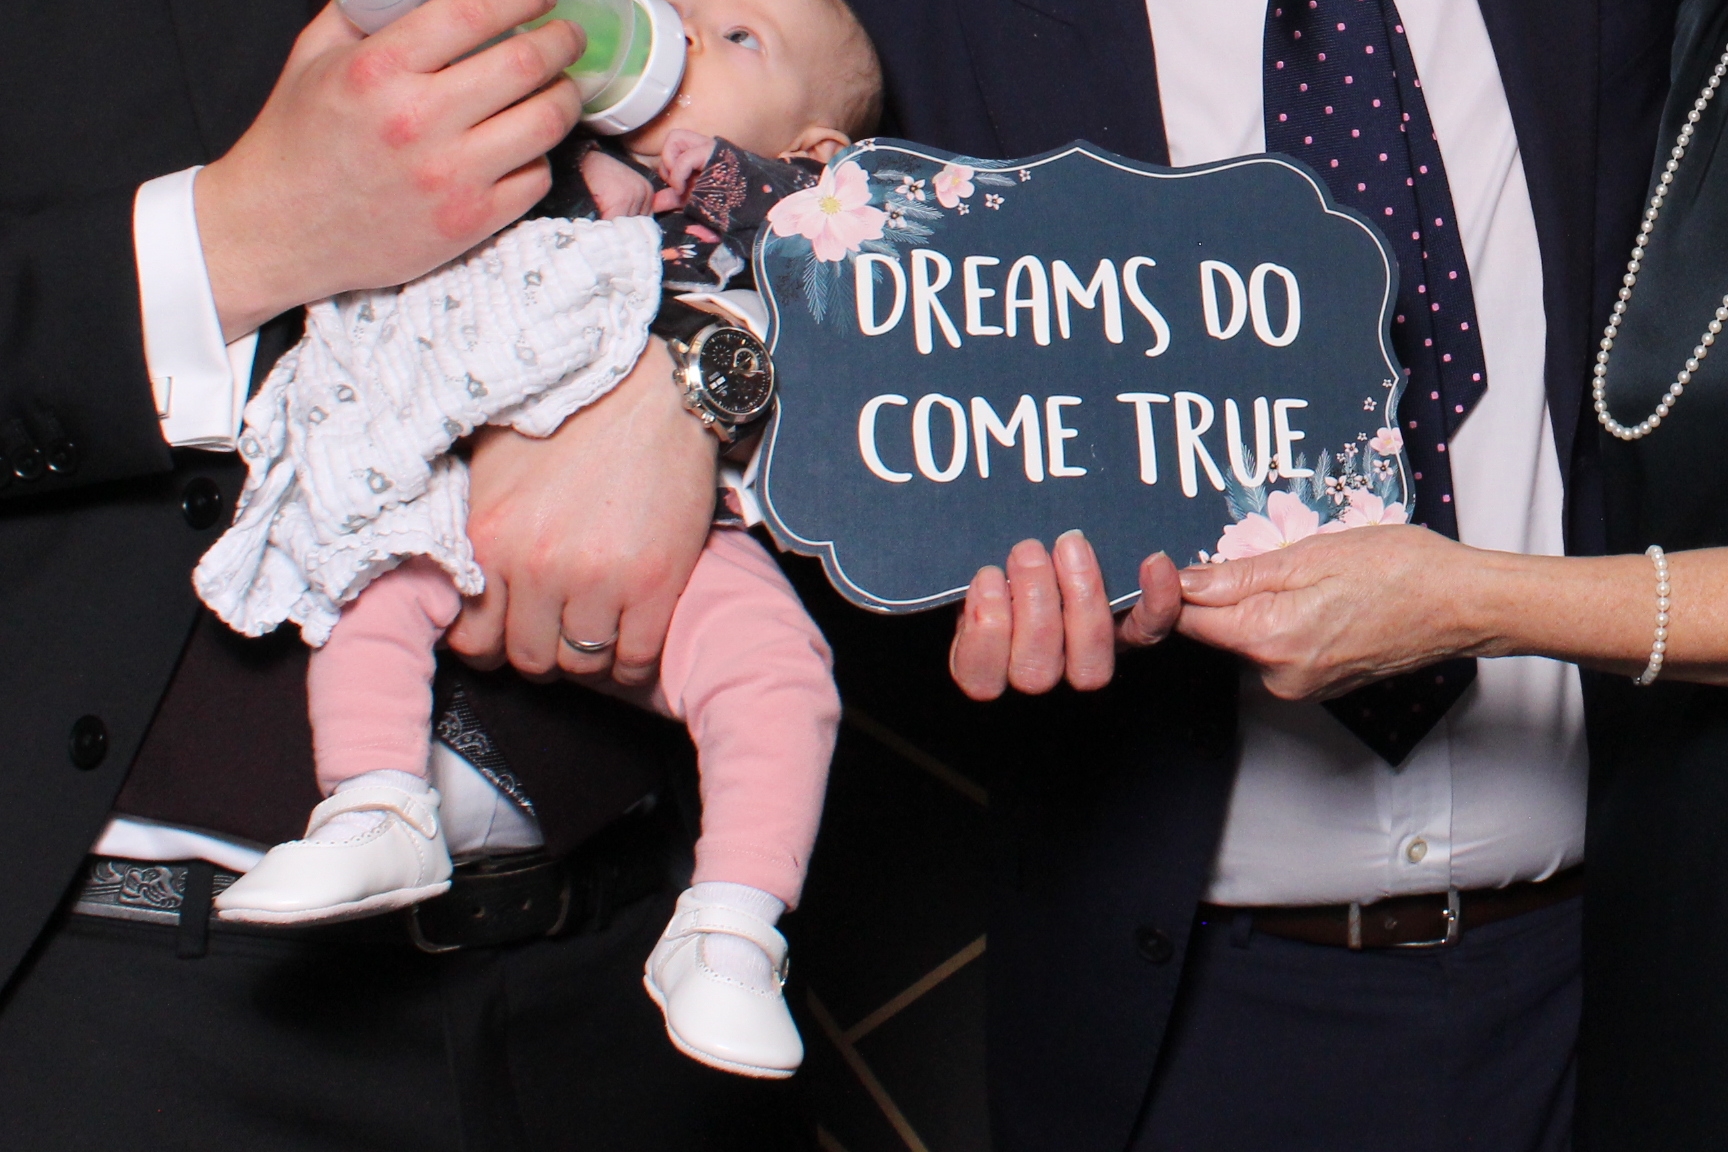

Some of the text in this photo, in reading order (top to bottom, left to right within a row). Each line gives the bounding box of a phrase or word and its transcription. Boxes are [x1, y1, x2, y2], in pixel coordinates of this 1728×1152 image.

[853, 248, 1302, 357] DREAMS DO
[857, 391, 1316, 498] COME TRUE
